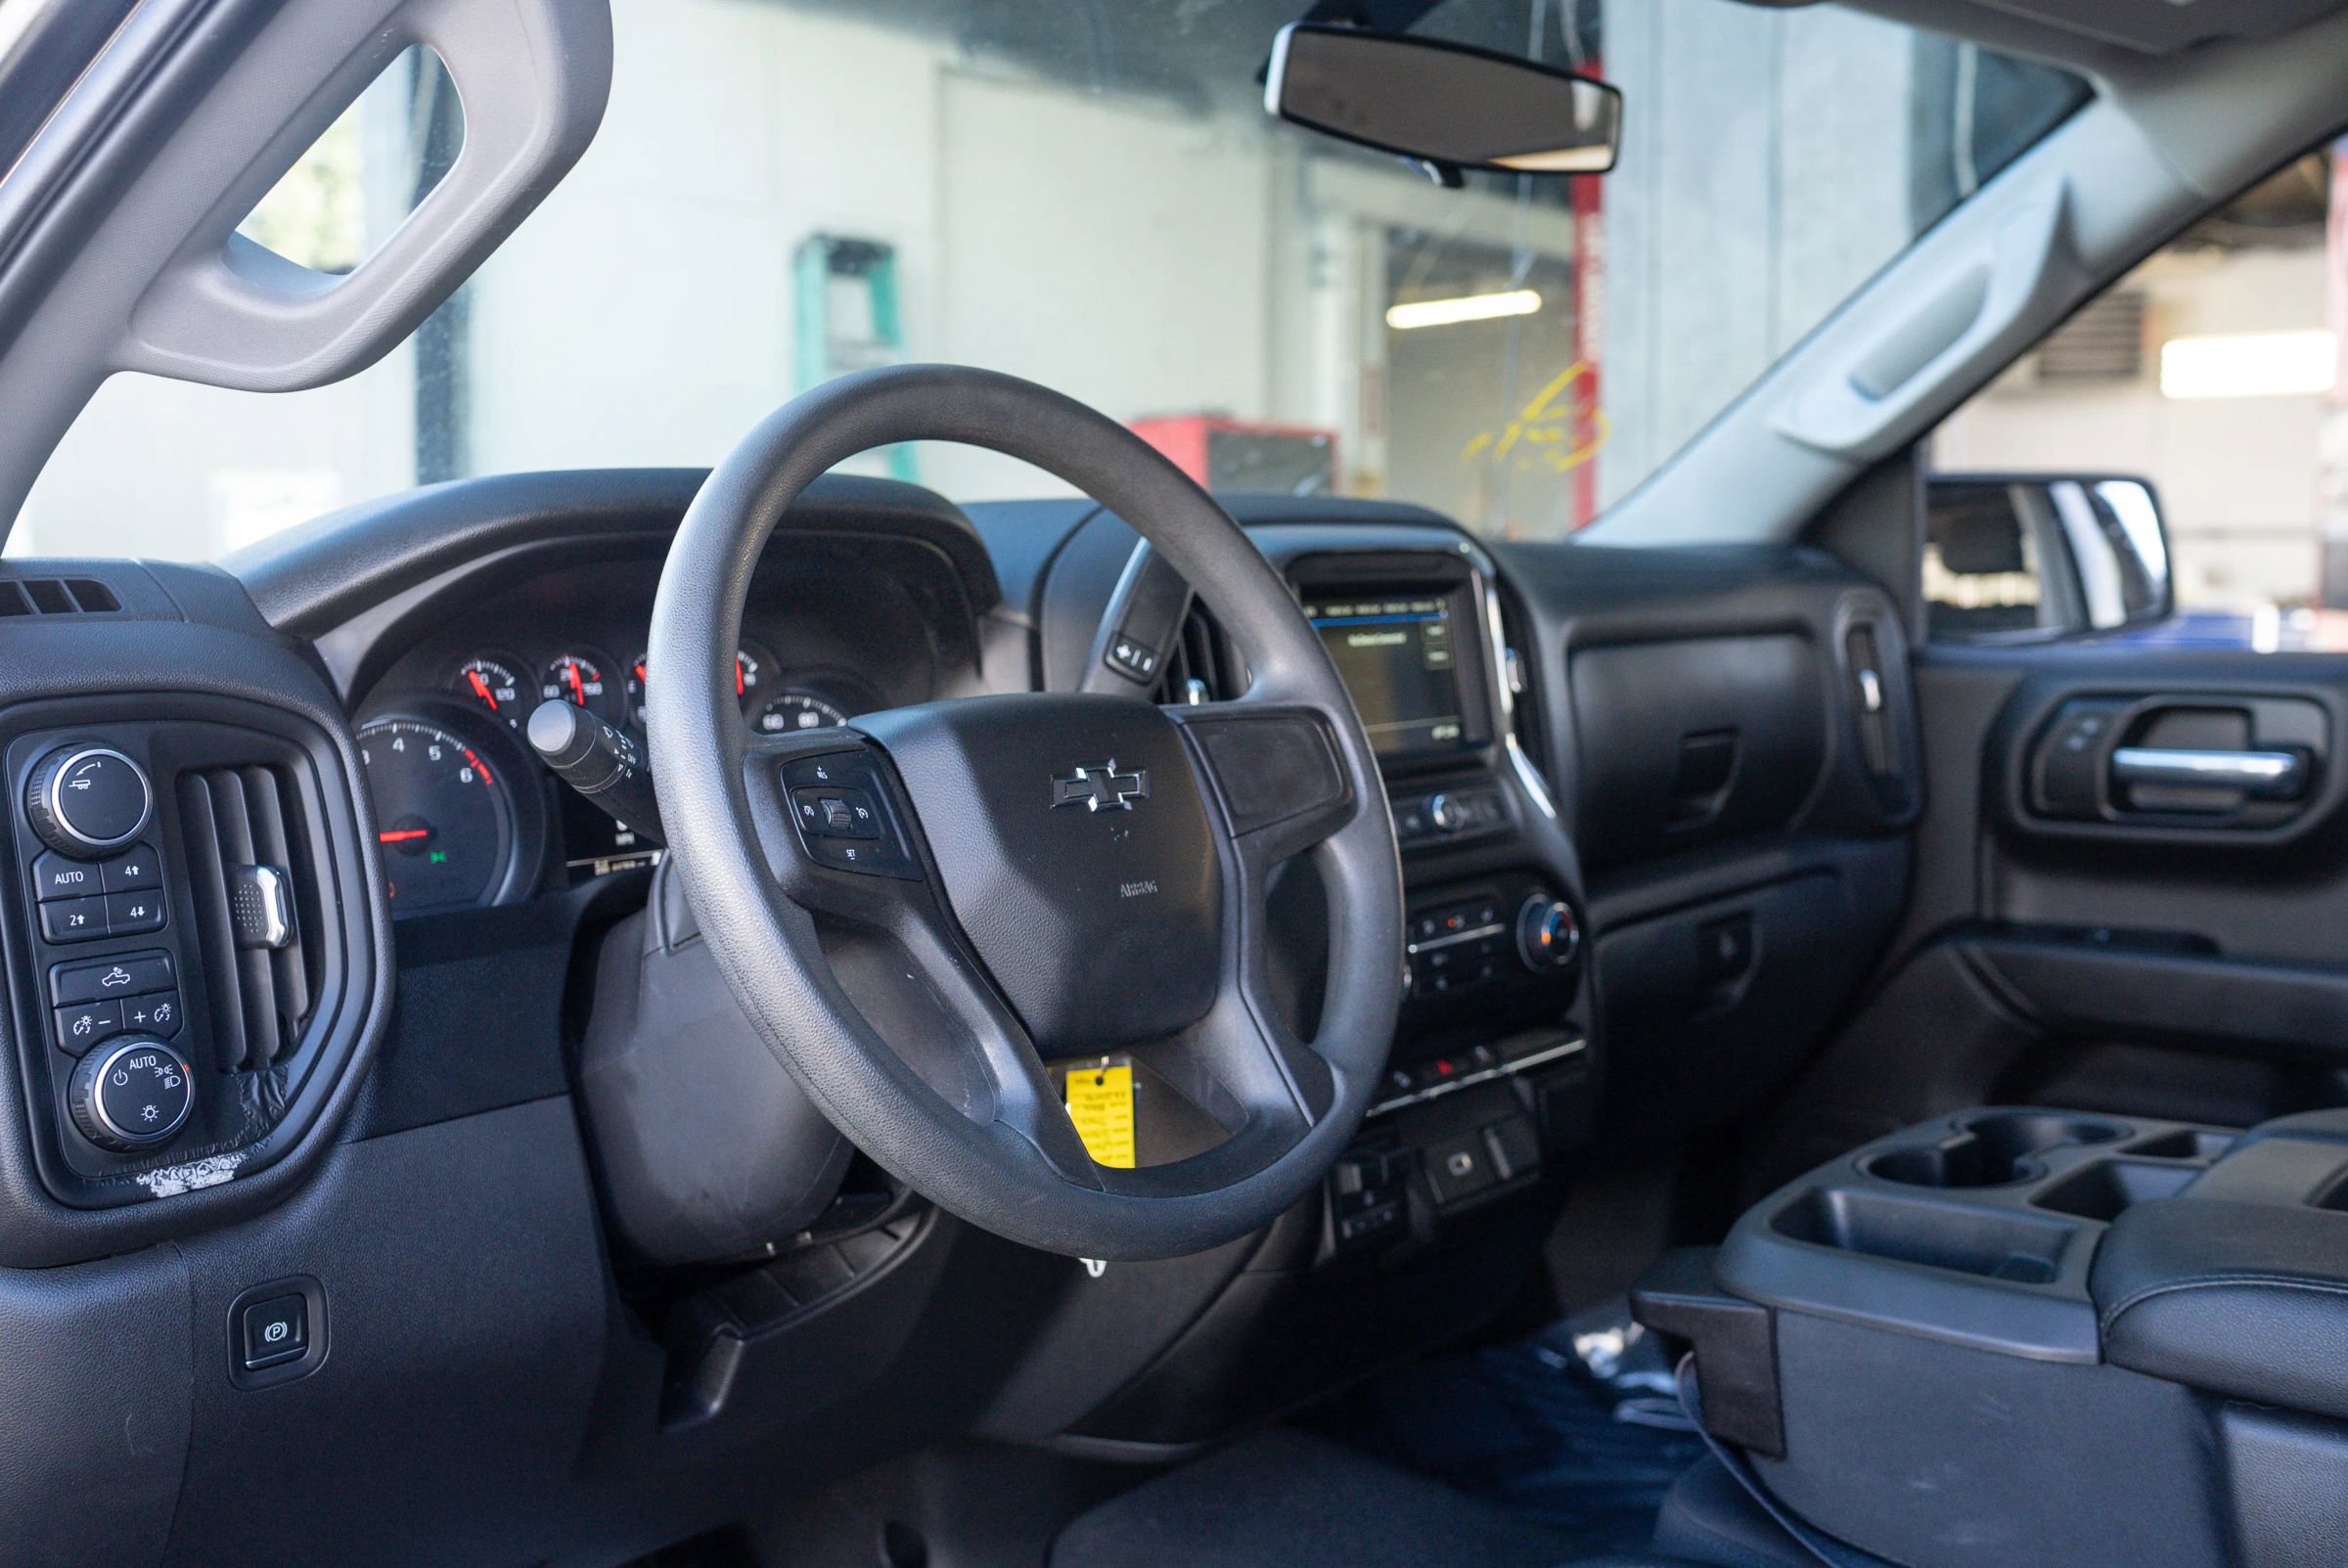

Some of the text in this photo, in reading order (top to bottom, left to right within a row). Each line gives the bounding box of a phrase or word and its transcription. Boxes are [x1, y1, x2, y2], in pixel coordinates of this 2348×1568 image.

[495, 688, 516, 701] 120
[392, 738, 404, 752] 4
[429, 745, 441, 761] 5
[460, 767, 474, 783] 6
[845, 848, 856, 858] SET
[124, 866, 132, 876] 4
[54, 871, 84, 885] AUTO
[129, 907, 138, 918] 4
[69, 915, 77, 926] 2
[129, 1055, 157, 1070] AUTO
